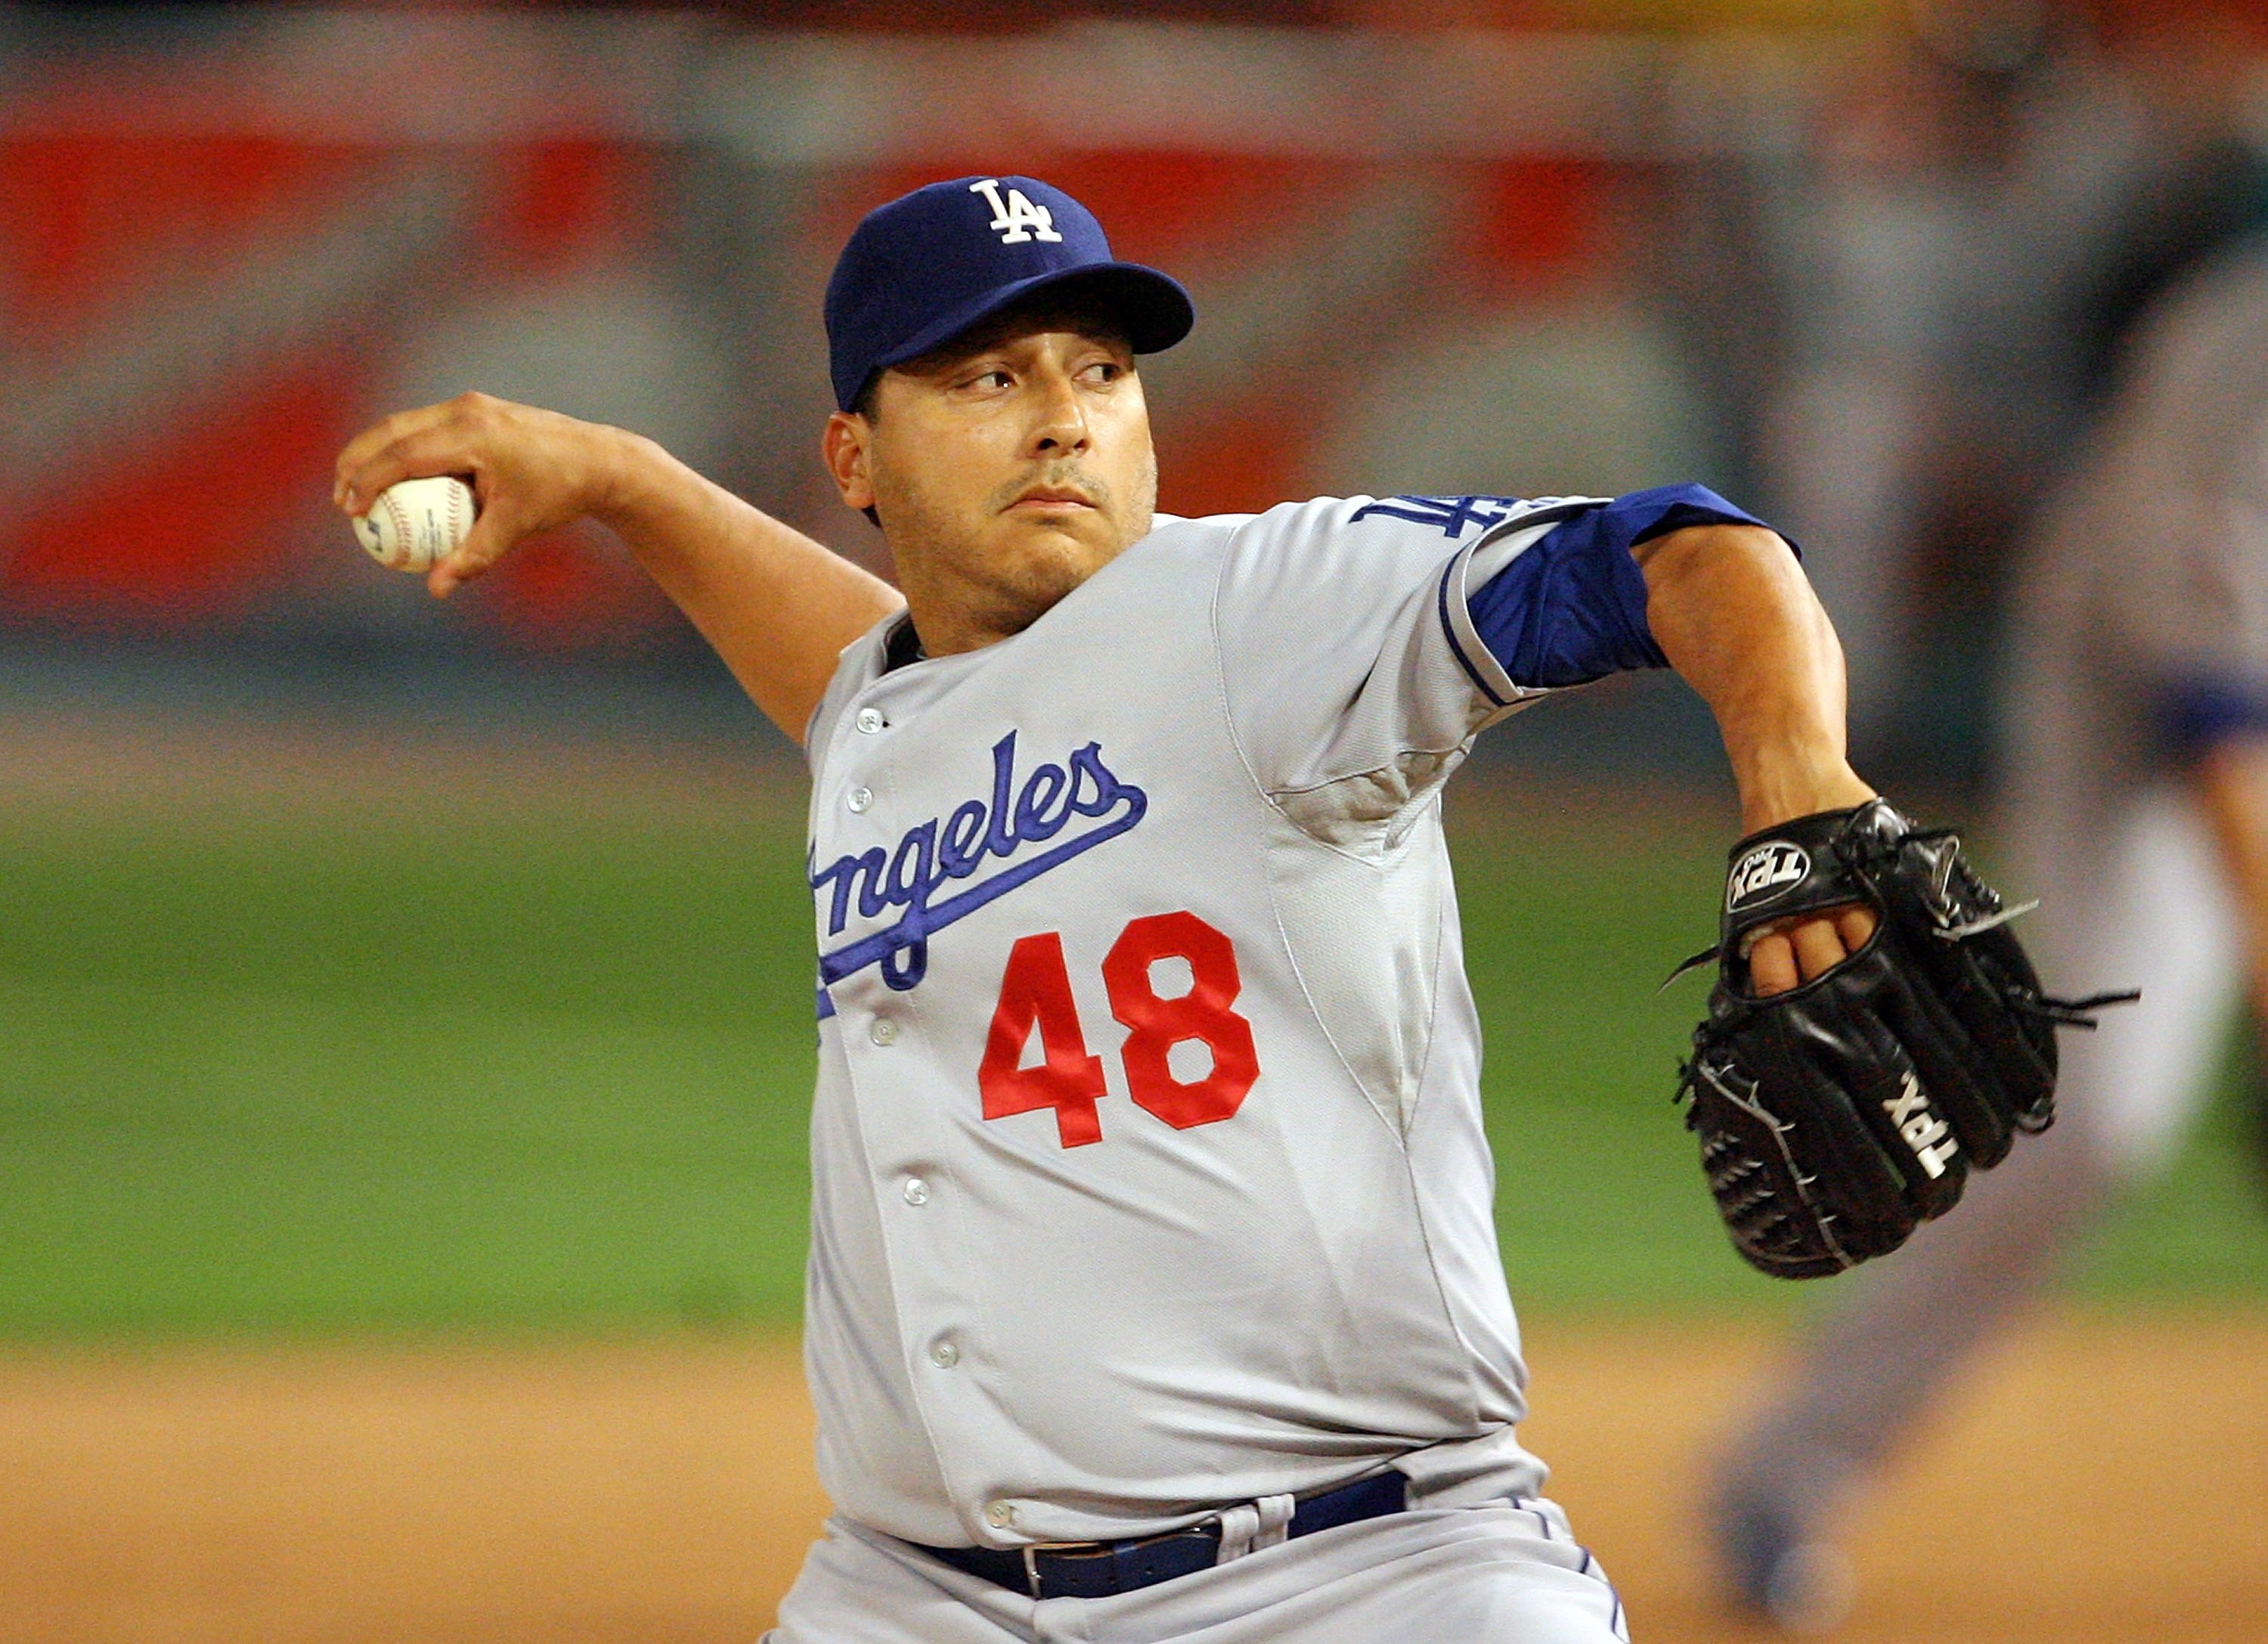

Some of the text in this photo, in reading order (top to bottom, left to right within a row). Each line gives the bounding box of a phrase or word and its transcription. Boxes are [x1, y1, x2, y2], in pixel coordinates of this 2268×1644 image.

[969, 179, 1062, 243] LA
[811, 729, 1148, 990] ngeles
[1732, 852, 1802, 905] TPX
[978, 910, 1261, 1149] 48
[1882, 1075, 1960, 1179] TPX
